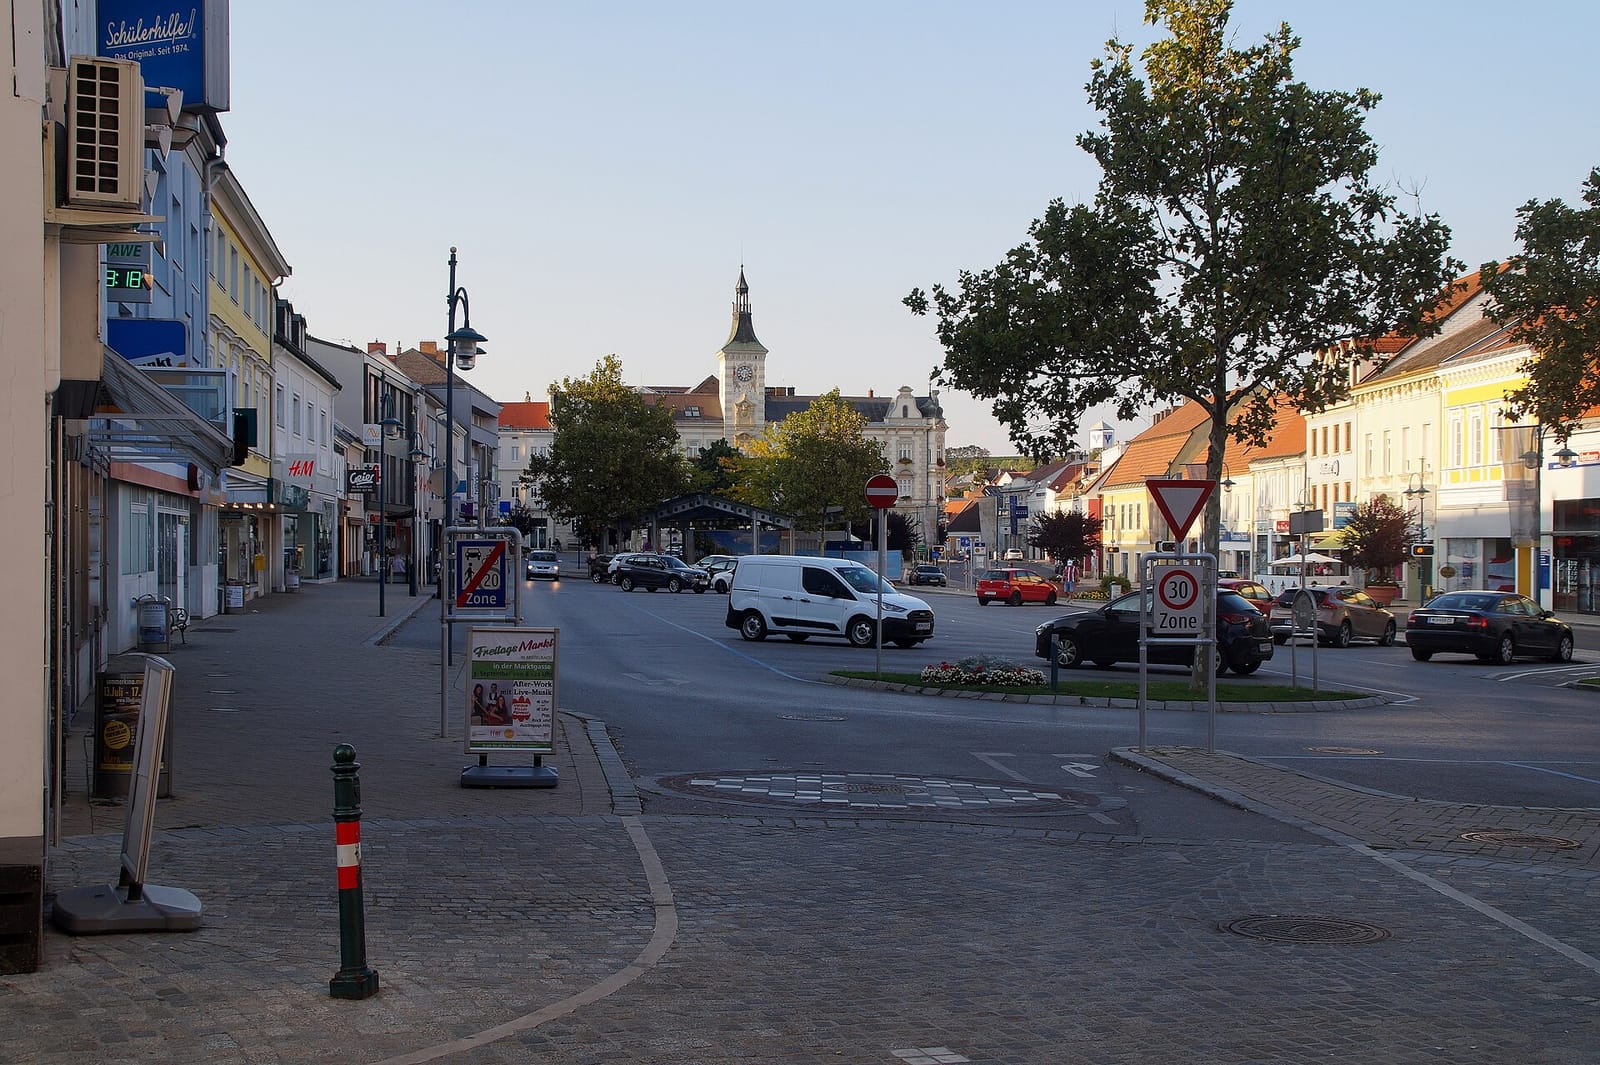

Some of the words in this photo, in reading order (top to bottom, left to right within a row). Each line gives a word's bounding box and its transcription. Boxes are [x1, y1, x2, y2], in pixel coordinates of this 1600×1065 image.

[127, 49, 156, 60] Original.
[157, 47, 171, 56] Seit
[172, 43, 189, 53] 1974.
[107, 244, 142, 257] AWE
[288, 460, 314, 477] H&M
[484, 574, 499, 587] 20
[1169, 581, 1188, 598] 30
[466, 593, 497, 604] Zone
[1160, 612, 1197, 629] Zone
[473, 645, 518, 657] Freitags
[518, 638, 554, 652] Markt
[514, 663, 551, 671] Marktgasse
